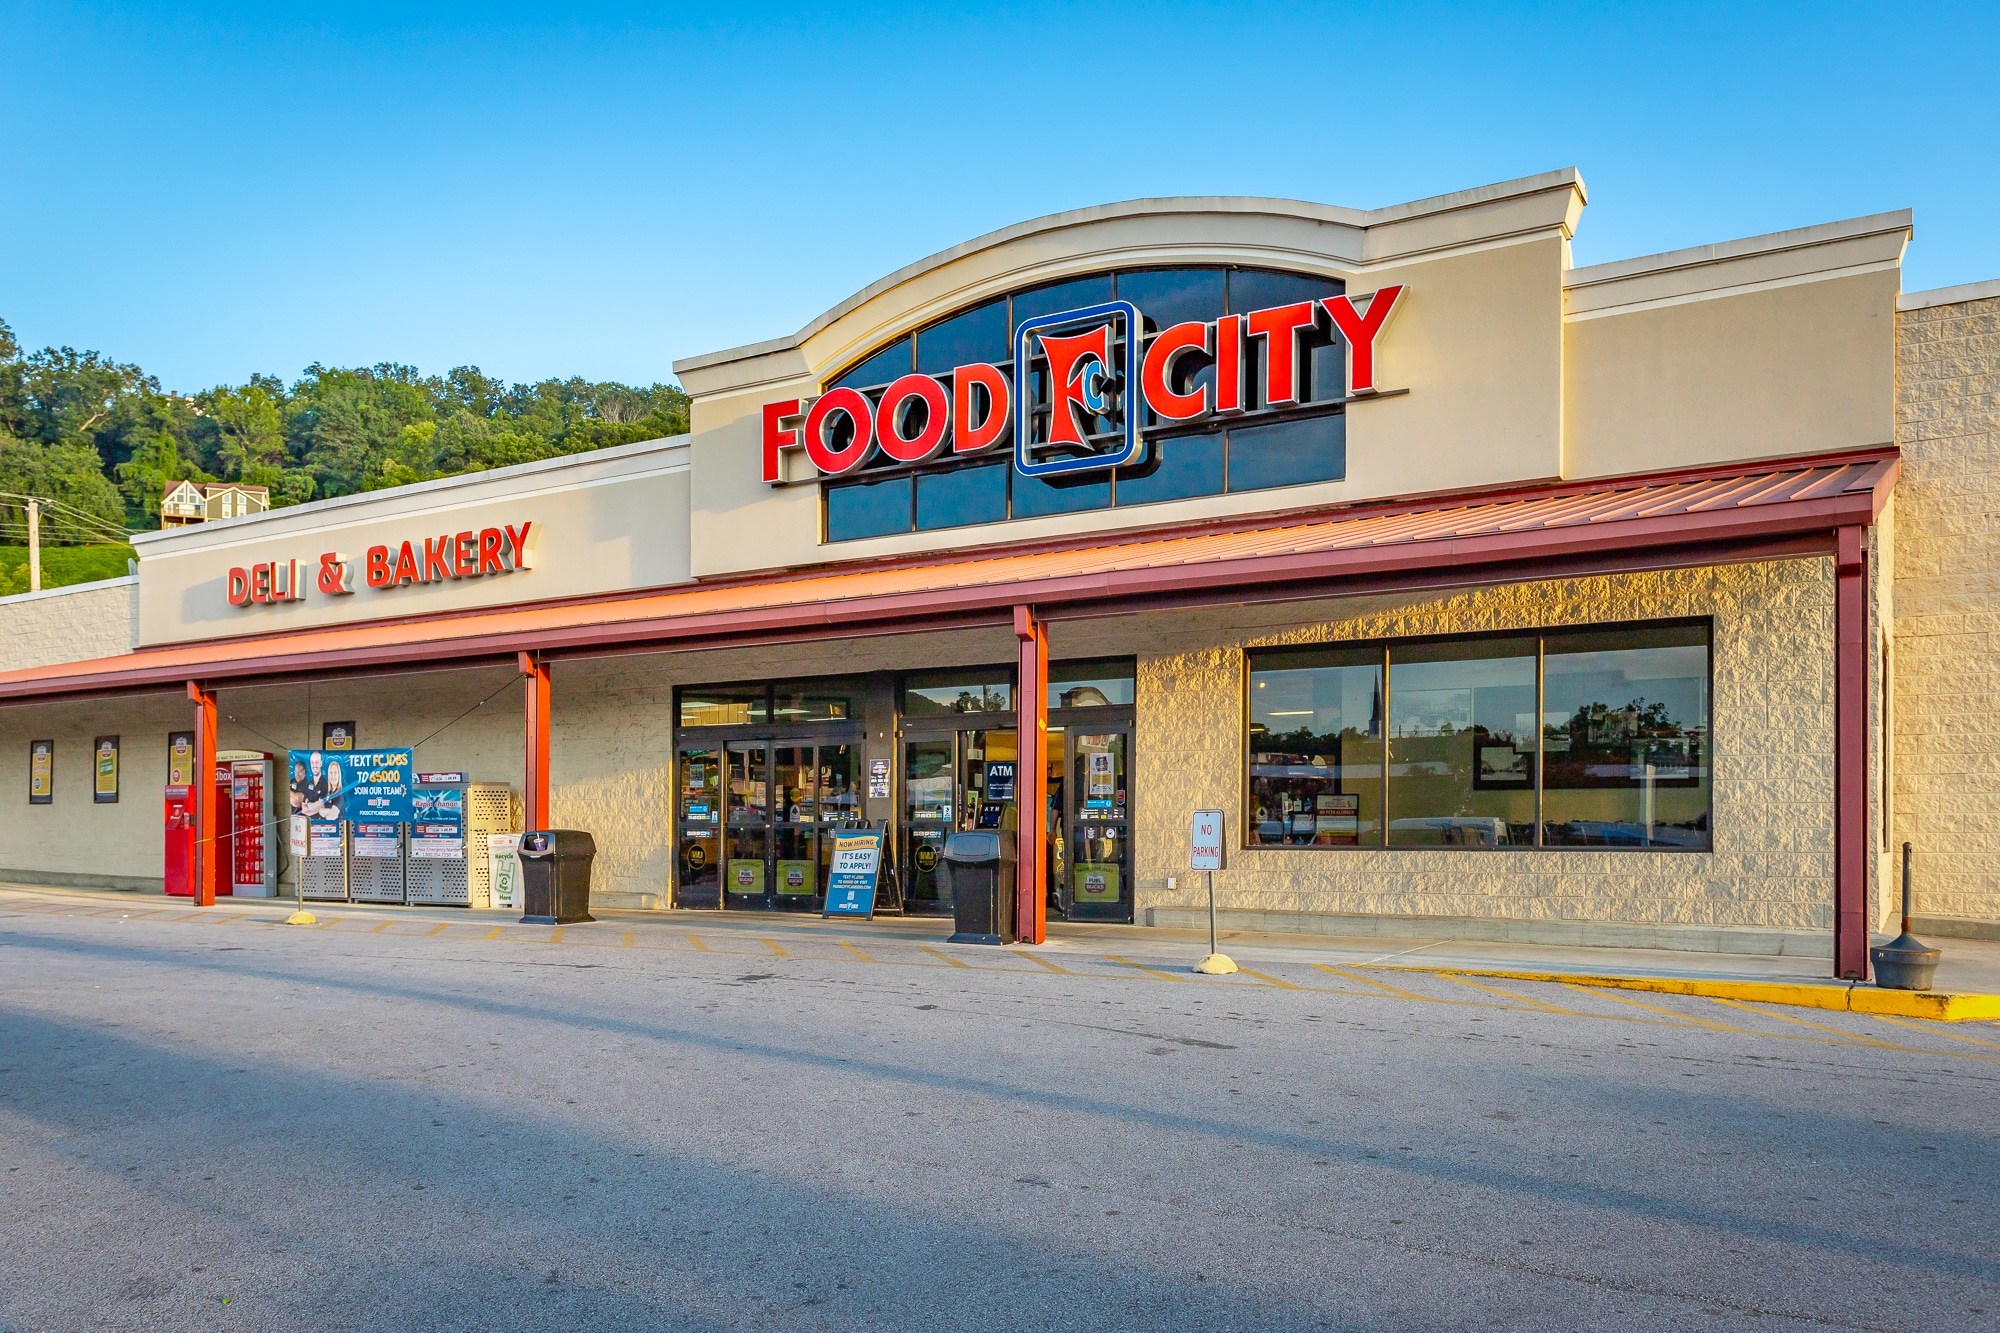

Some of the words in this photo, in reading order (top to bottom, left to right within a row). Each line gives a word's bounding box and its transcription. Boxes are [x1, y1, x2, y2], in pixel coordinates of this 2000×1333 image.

[761, 362, 1012, 484] FOOD
[1141, 283, 1410, 420] CITY
[226, 557, 304, 606] DELI
[316, 552, 350, 595] &
[364, 520, 538, 589] BAKERY
[349, 754, 371, 767] TEXT
[372, 753, 408, 766] FCJOBS
[356, 771, 369, 783] TO
[370, 769, 400, 782] 65000
[989, 765, 1013, 776] ATM
[353, 786, 368, 795] JOIN
[369, 786, 382, 795] OUR
[383, 786, 402, 795] TEAM!
[1200, 824, 1213, 836] NO
[854, 852, 872, 860] EASY
[1192, 846, 1219, 858] PARKING
